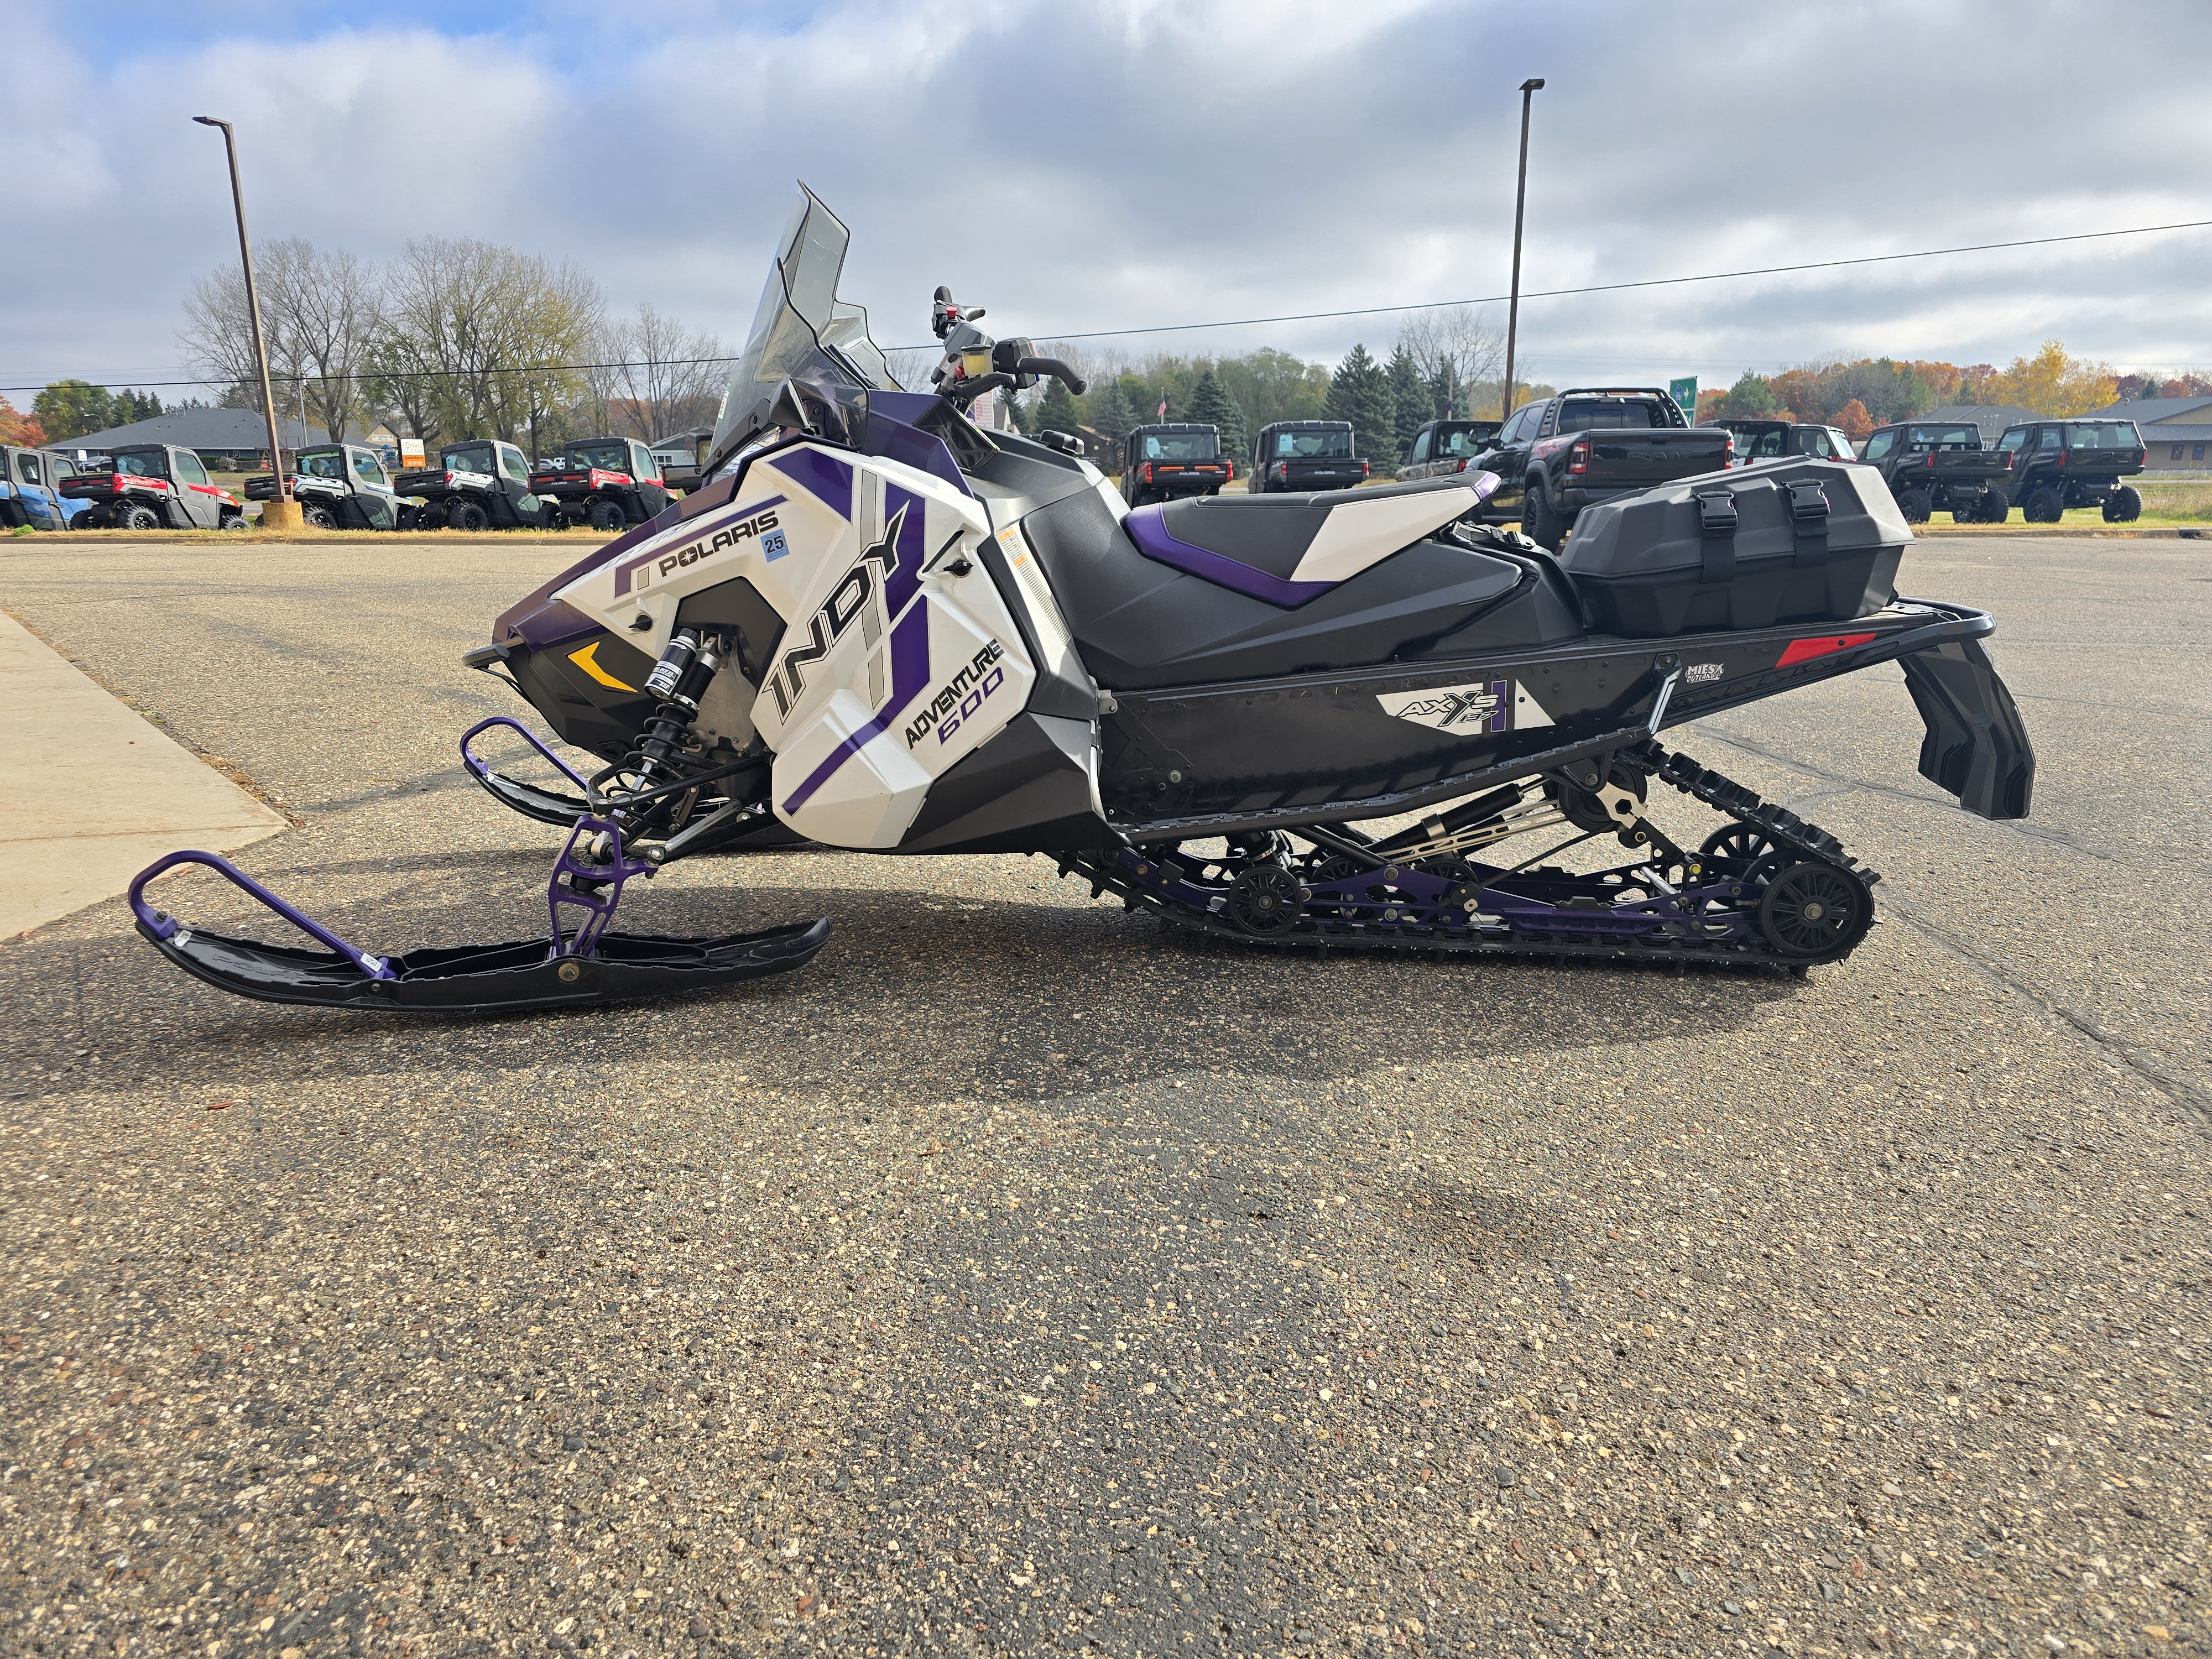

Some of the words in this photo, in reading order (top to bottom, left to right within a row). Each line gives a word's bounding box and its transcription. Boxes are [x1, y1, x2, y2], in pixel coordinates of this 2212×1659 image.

[658, 510, 779, 577] POLARIS
[765, 535, 784, 554] 25
[761, 498, 911, 726] INDY
[1686, 672, 1715, 683] OUTLAND
[1687, 664, 1716, 675] MIES
[905, 638, 1005, 750] ADVENTURE
[937, 666, 1004, 747] 600
[1457, 710, 1499, 723] 137
